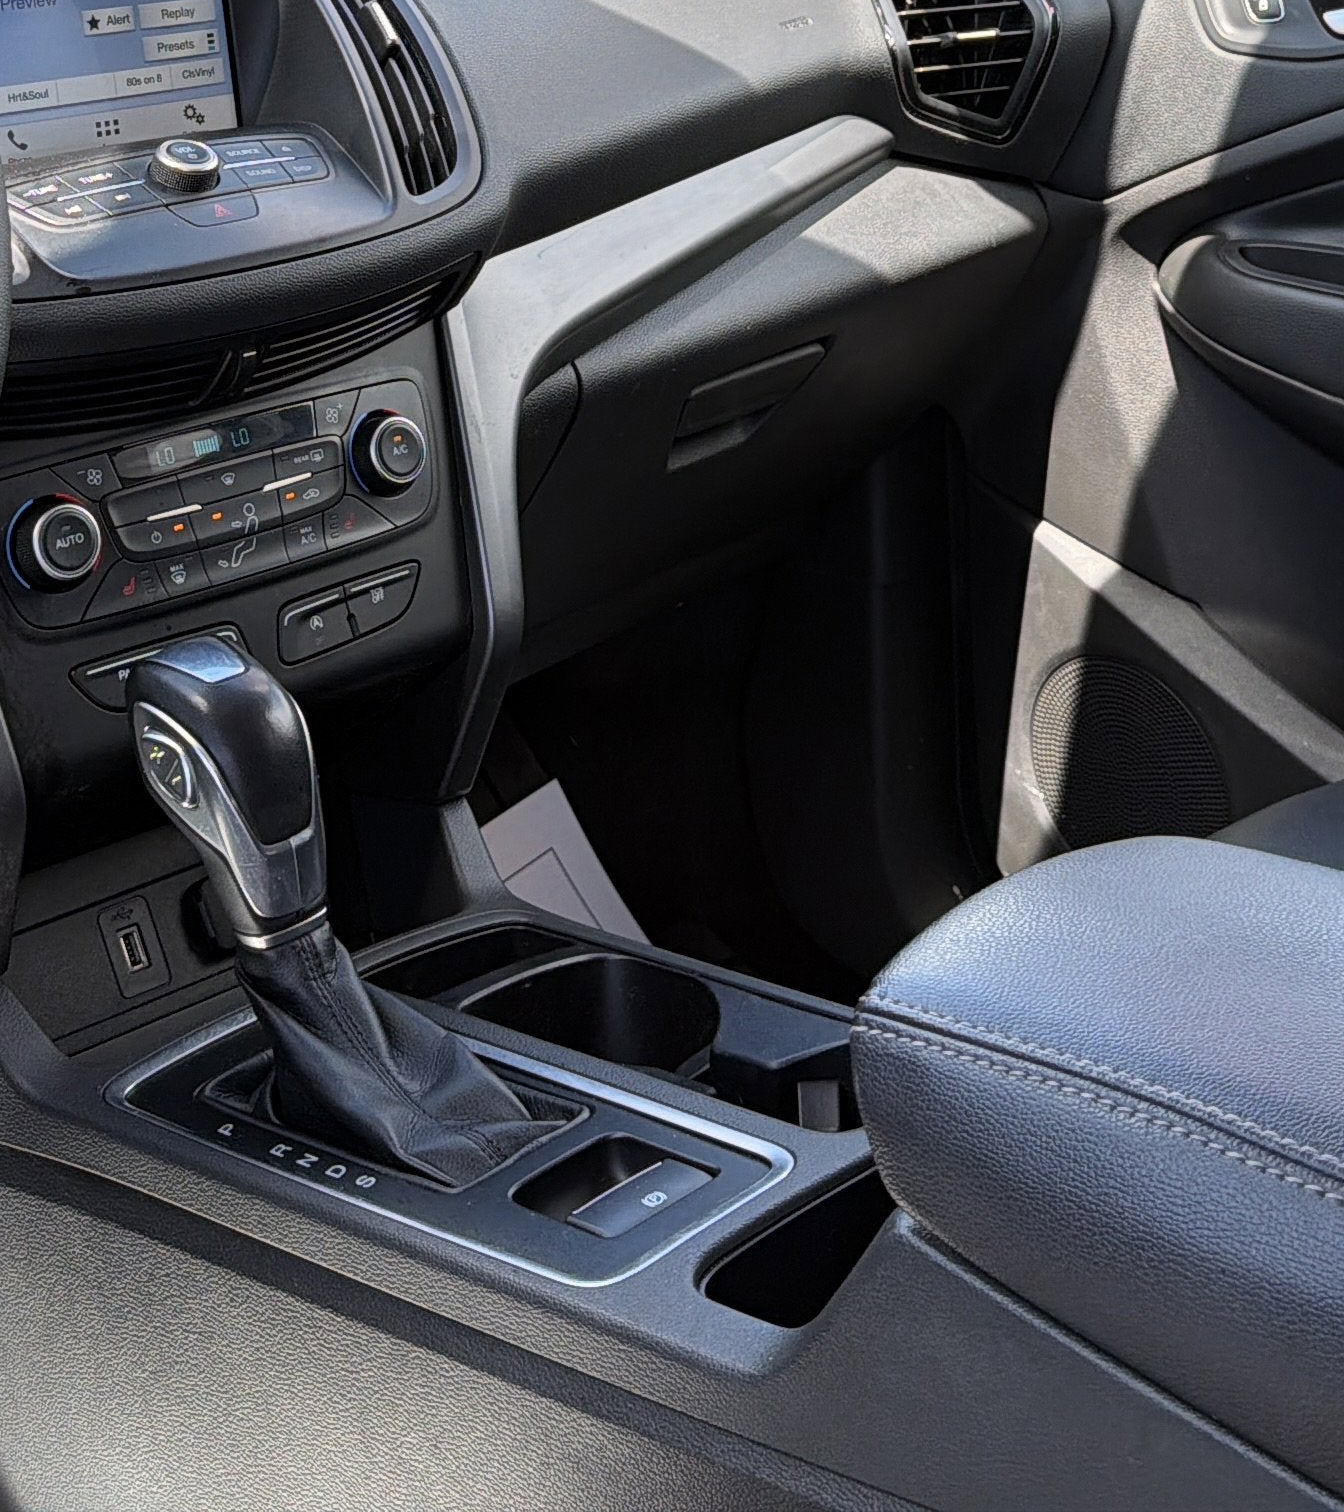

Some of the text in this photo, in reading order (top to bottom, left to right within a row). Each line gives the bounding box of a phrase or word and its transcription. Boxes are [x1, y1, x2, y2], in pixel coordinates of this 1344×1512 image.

[106, 13, 131, 27] Alert
[160, 6, 195, 21] Replay
[156, 40, 195, 54] Presets
[7, 88, 49, 104] Hrt&Soul
[126, 75, 142, 87] 80s
[143, 75, 155, 85] on
[181, 66, 216, 80] ClsVinyl
[392, 444, 409, 456] A/C
[299, 526, 313, 534] MAX
[55, 532, 85, 550] AUTO
[301, 532, 317, 545] A/C
[169, 563, 185, 572] MAX
[217, 1123, 377, 1189] P R N D S
